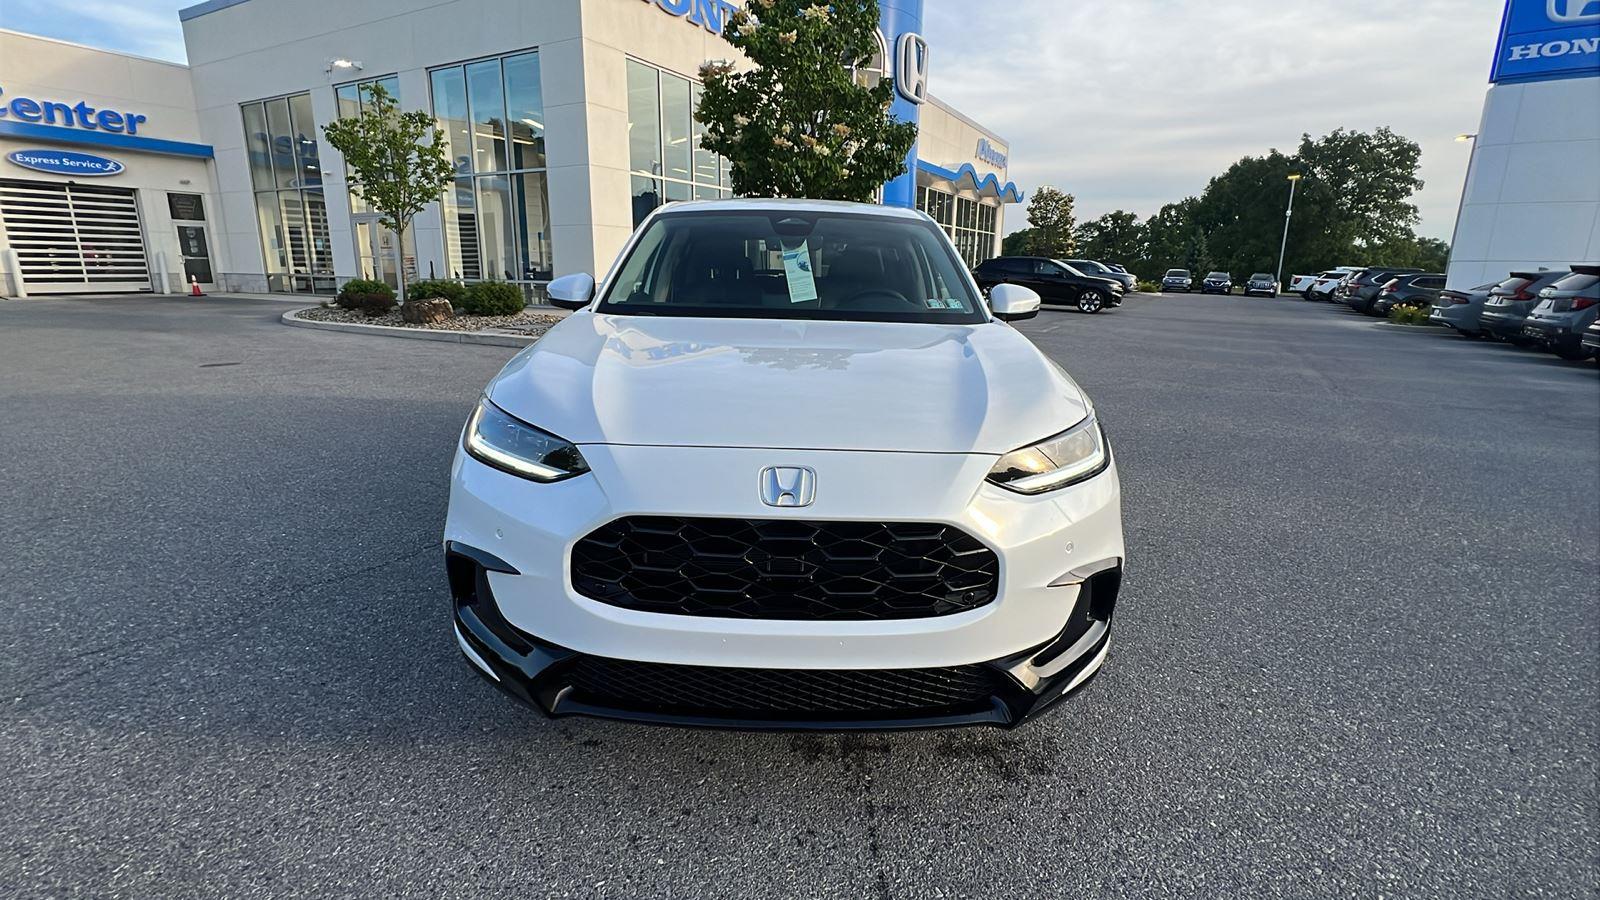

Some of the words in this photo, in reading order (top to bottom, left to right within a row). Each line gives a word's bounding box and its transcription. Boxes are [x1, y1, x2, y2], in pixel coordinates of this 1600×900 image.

[1508, 37, 1600, 61] HON
[0, 86, 147, 134] enter
[15, 153, 60, 165] Express
[62, 158, 102, 169] Service
